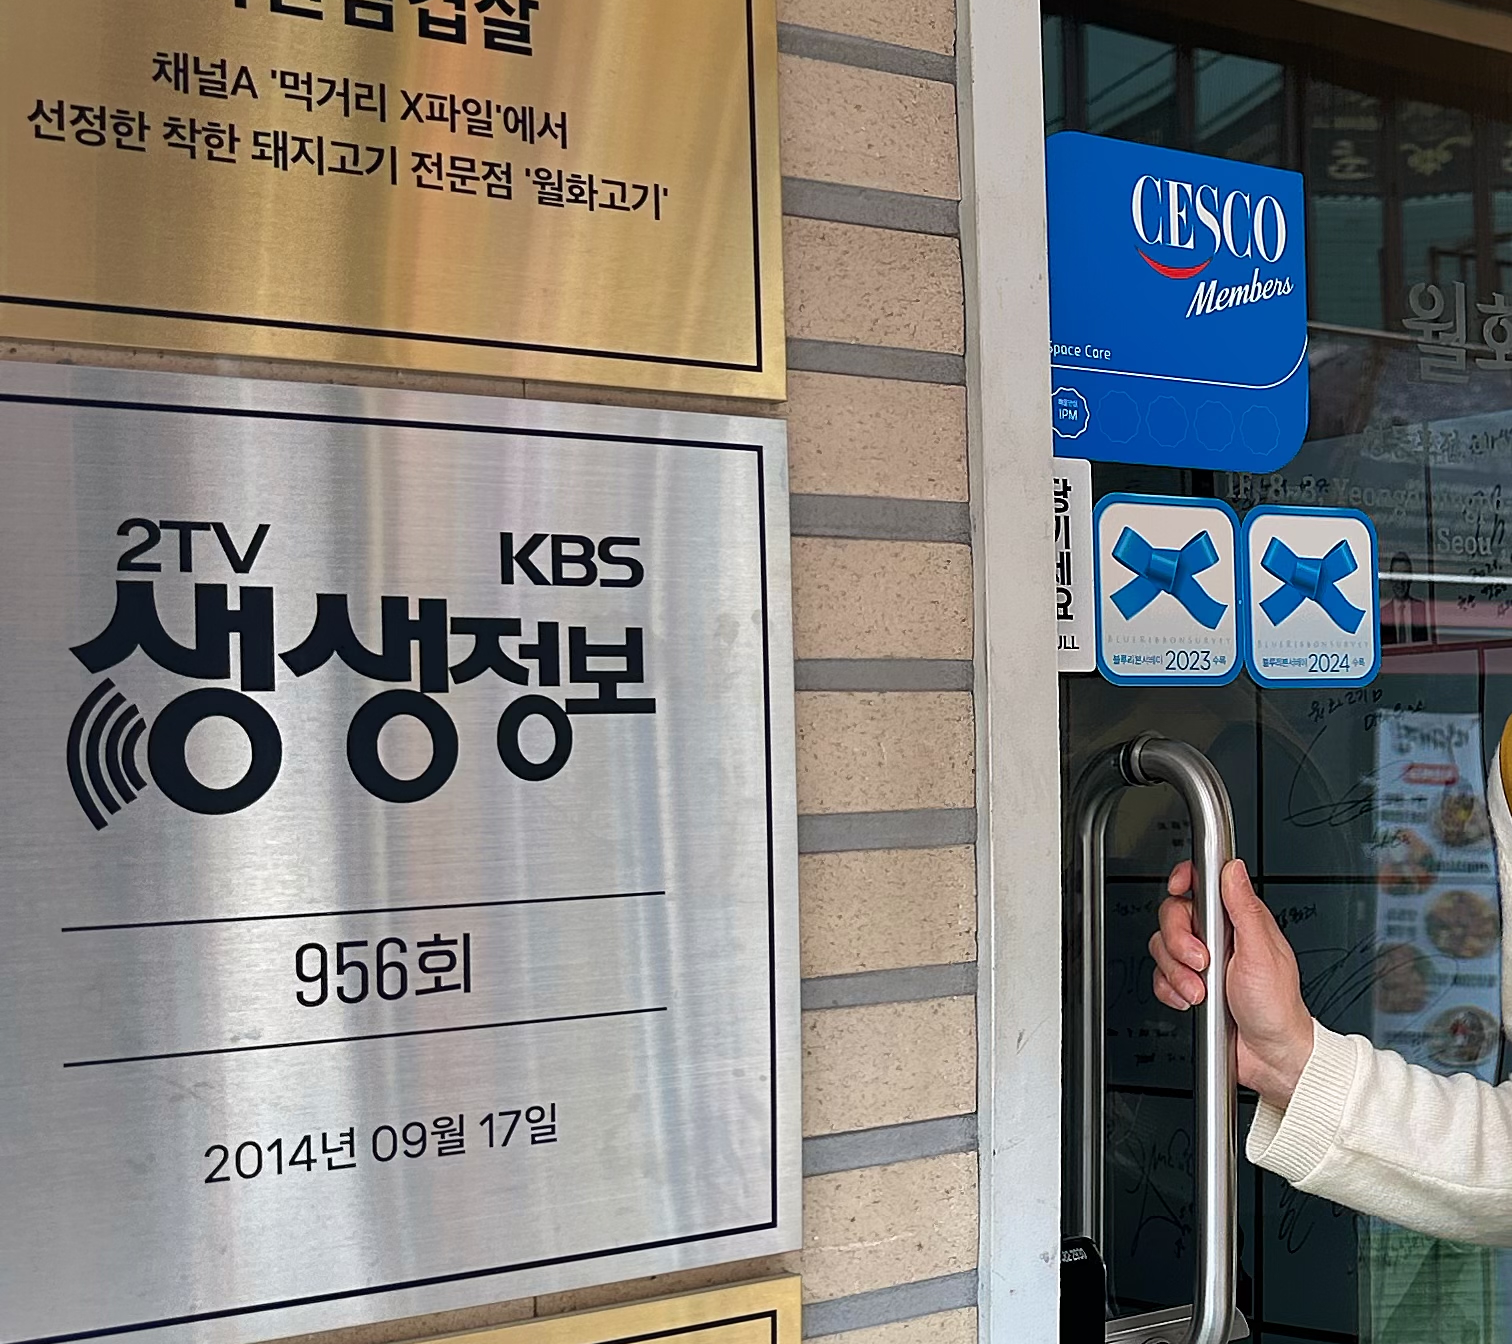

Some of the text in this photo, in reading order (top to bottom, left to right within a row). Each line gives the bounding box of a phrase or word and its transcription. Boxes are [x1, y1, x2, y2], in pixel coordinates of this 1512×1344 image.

[152, 51, 569, 150] 채널A '먹거리 X파일'에서
[27, 98, 669, 221] 선정한 착한 돼지고기 전문점 '월화고기'
[1131, 175, 1287, 263] CESCO
[1185, 268, 1295, 318] Members
[1085, 344, 1112, 361] Care
[1059, 408, 1078, 421] IPM
[117, 517, 270, 574] 2TV
[500, 531, 645, 588] KBS
[1165, 650, 1211, 671] 2023
[1308, 654, 1350, 672] 2024
[68, 581, 656, 815] 생생정보
[295, 933, 472, 1007] 956회
[204, 1103, 558, 1184] 2014년 09월 17일
